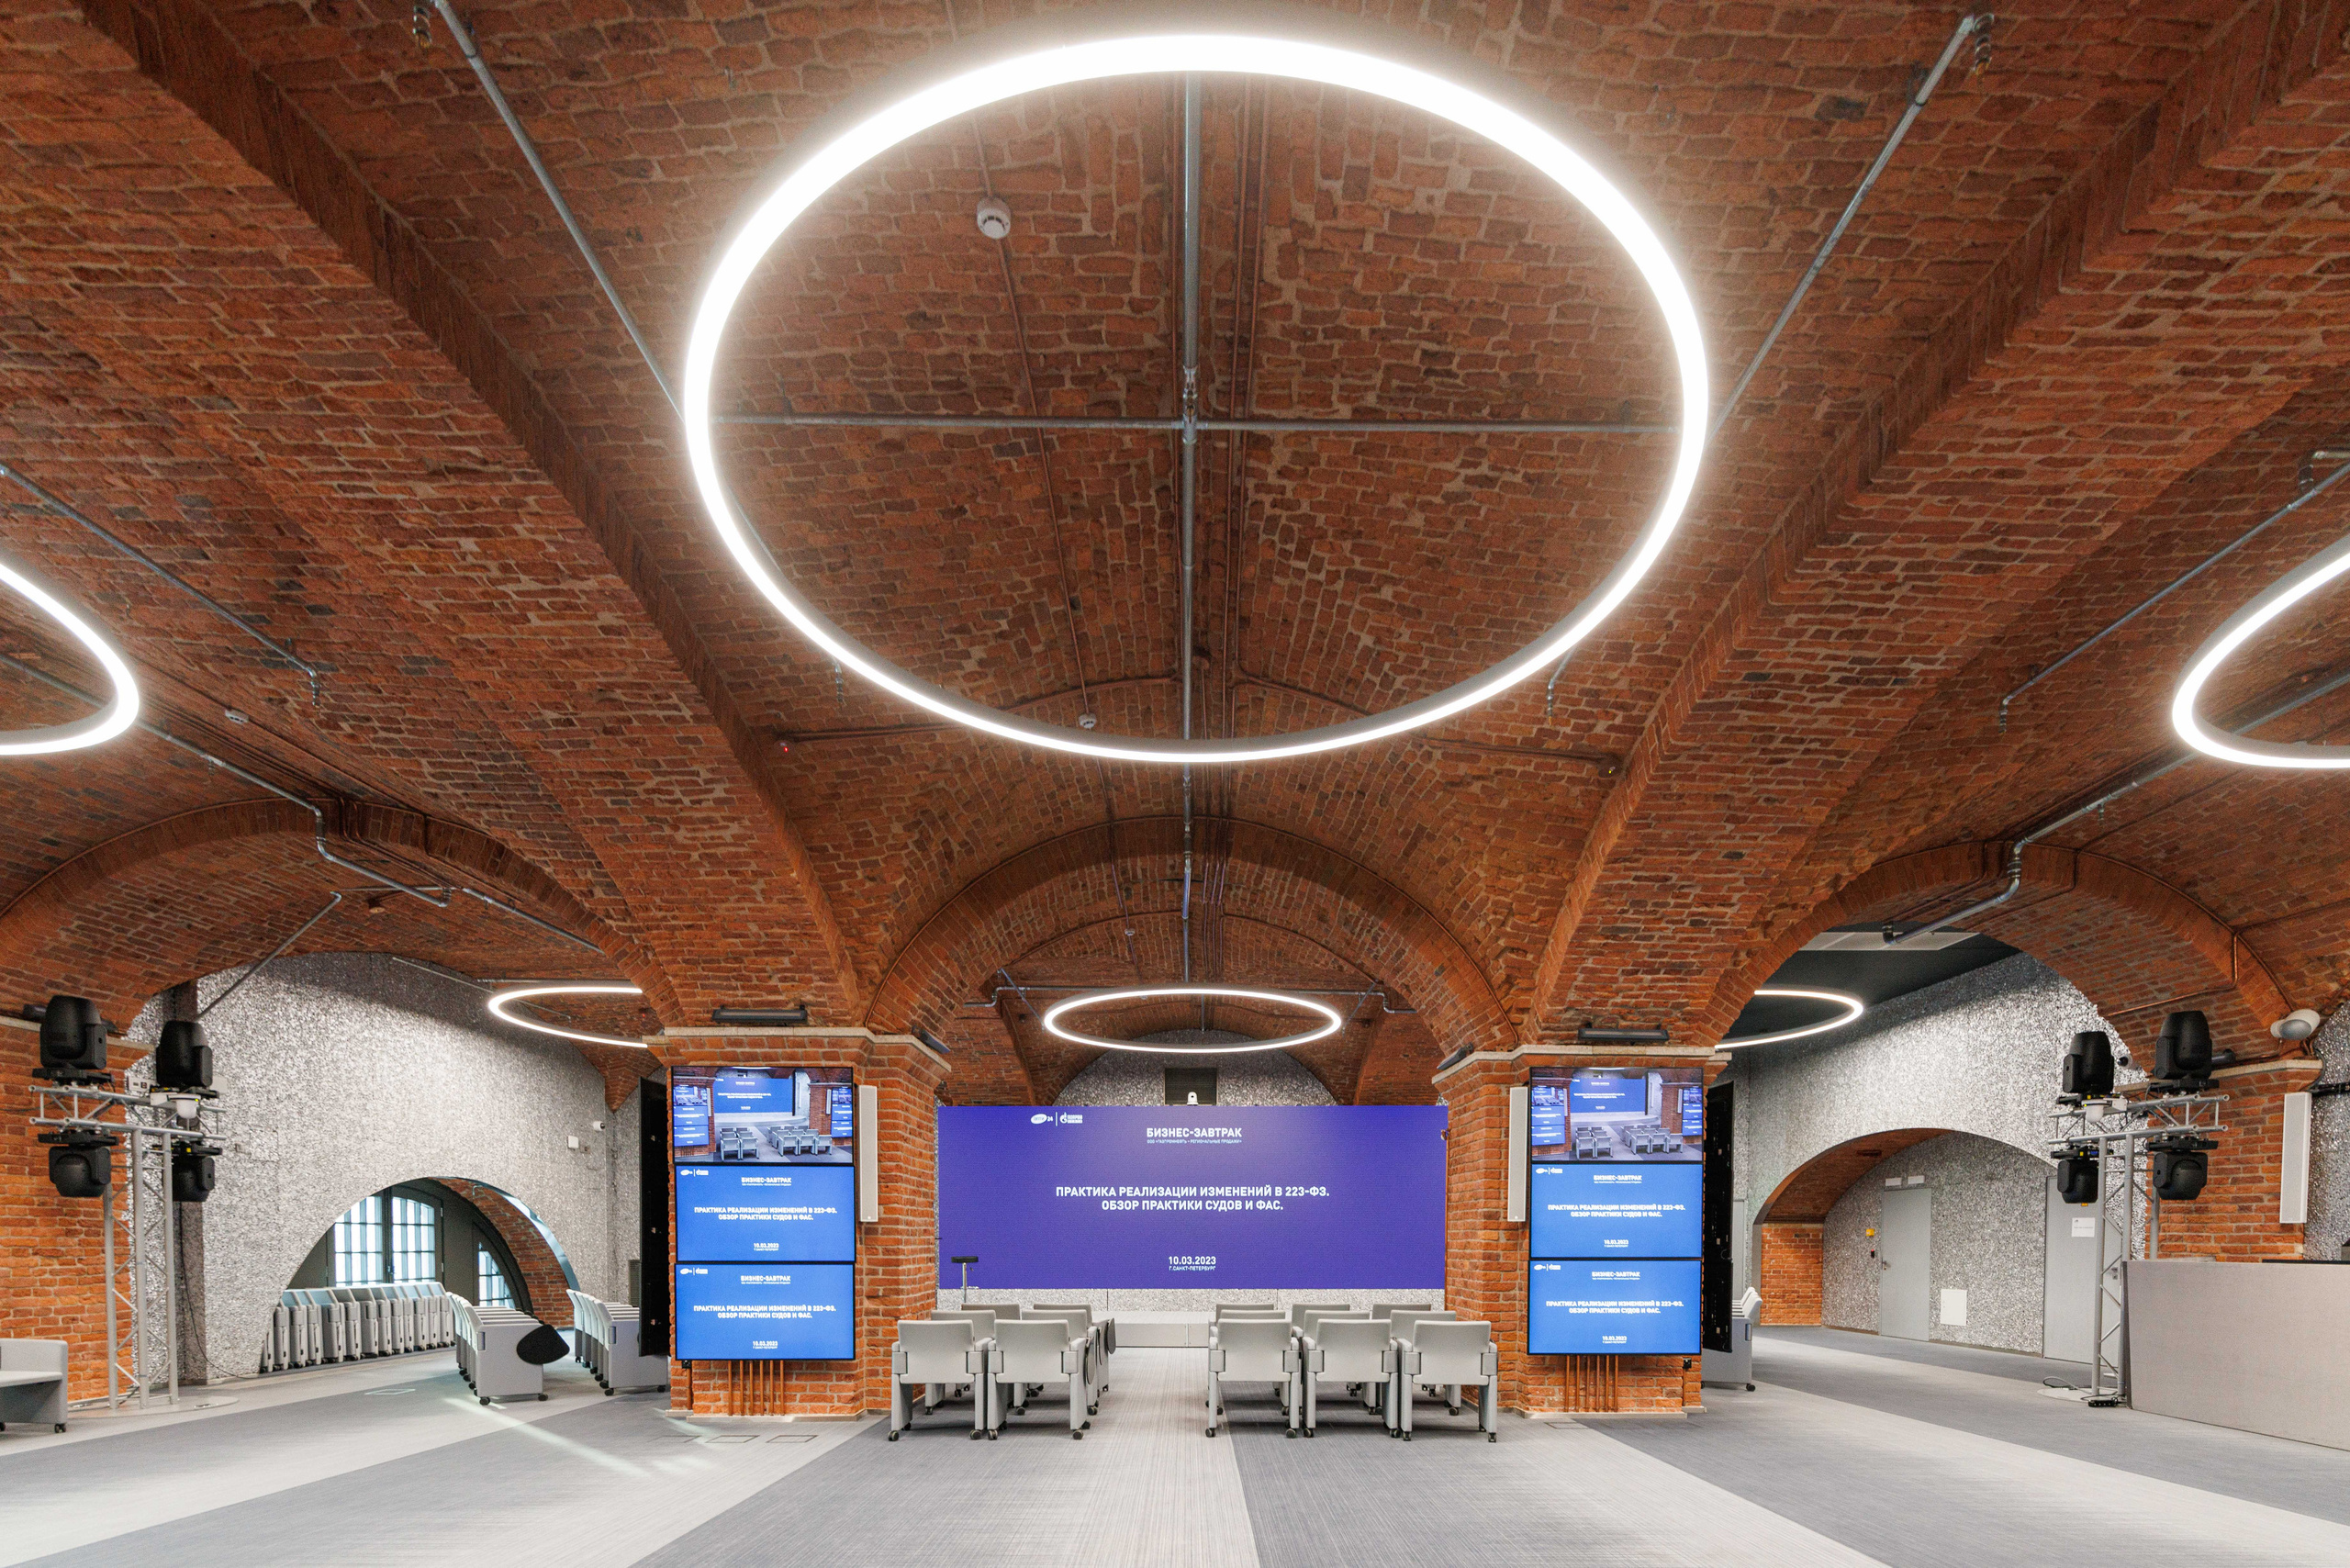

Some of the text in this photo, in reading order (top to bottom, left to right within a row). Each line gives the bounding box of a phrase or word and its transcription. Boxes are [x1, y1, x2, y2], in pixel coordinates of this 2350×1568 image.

[1147, 1128, 1242, 1137] БИЗНЕС-ЗАВТРАК
[1056, 1184, 1329, 1198] ПРАКТИКА РЕАЛИЗАЦИИ ИЗМЕНЕНИЙ В 223-ФЗ.
[1102, 1200, 1284, 1212] ОБЗОР ПРАКТИКИ СУДОВ И ФАС.
[1169, 1256, 1216, 1265] 10.03.2023
